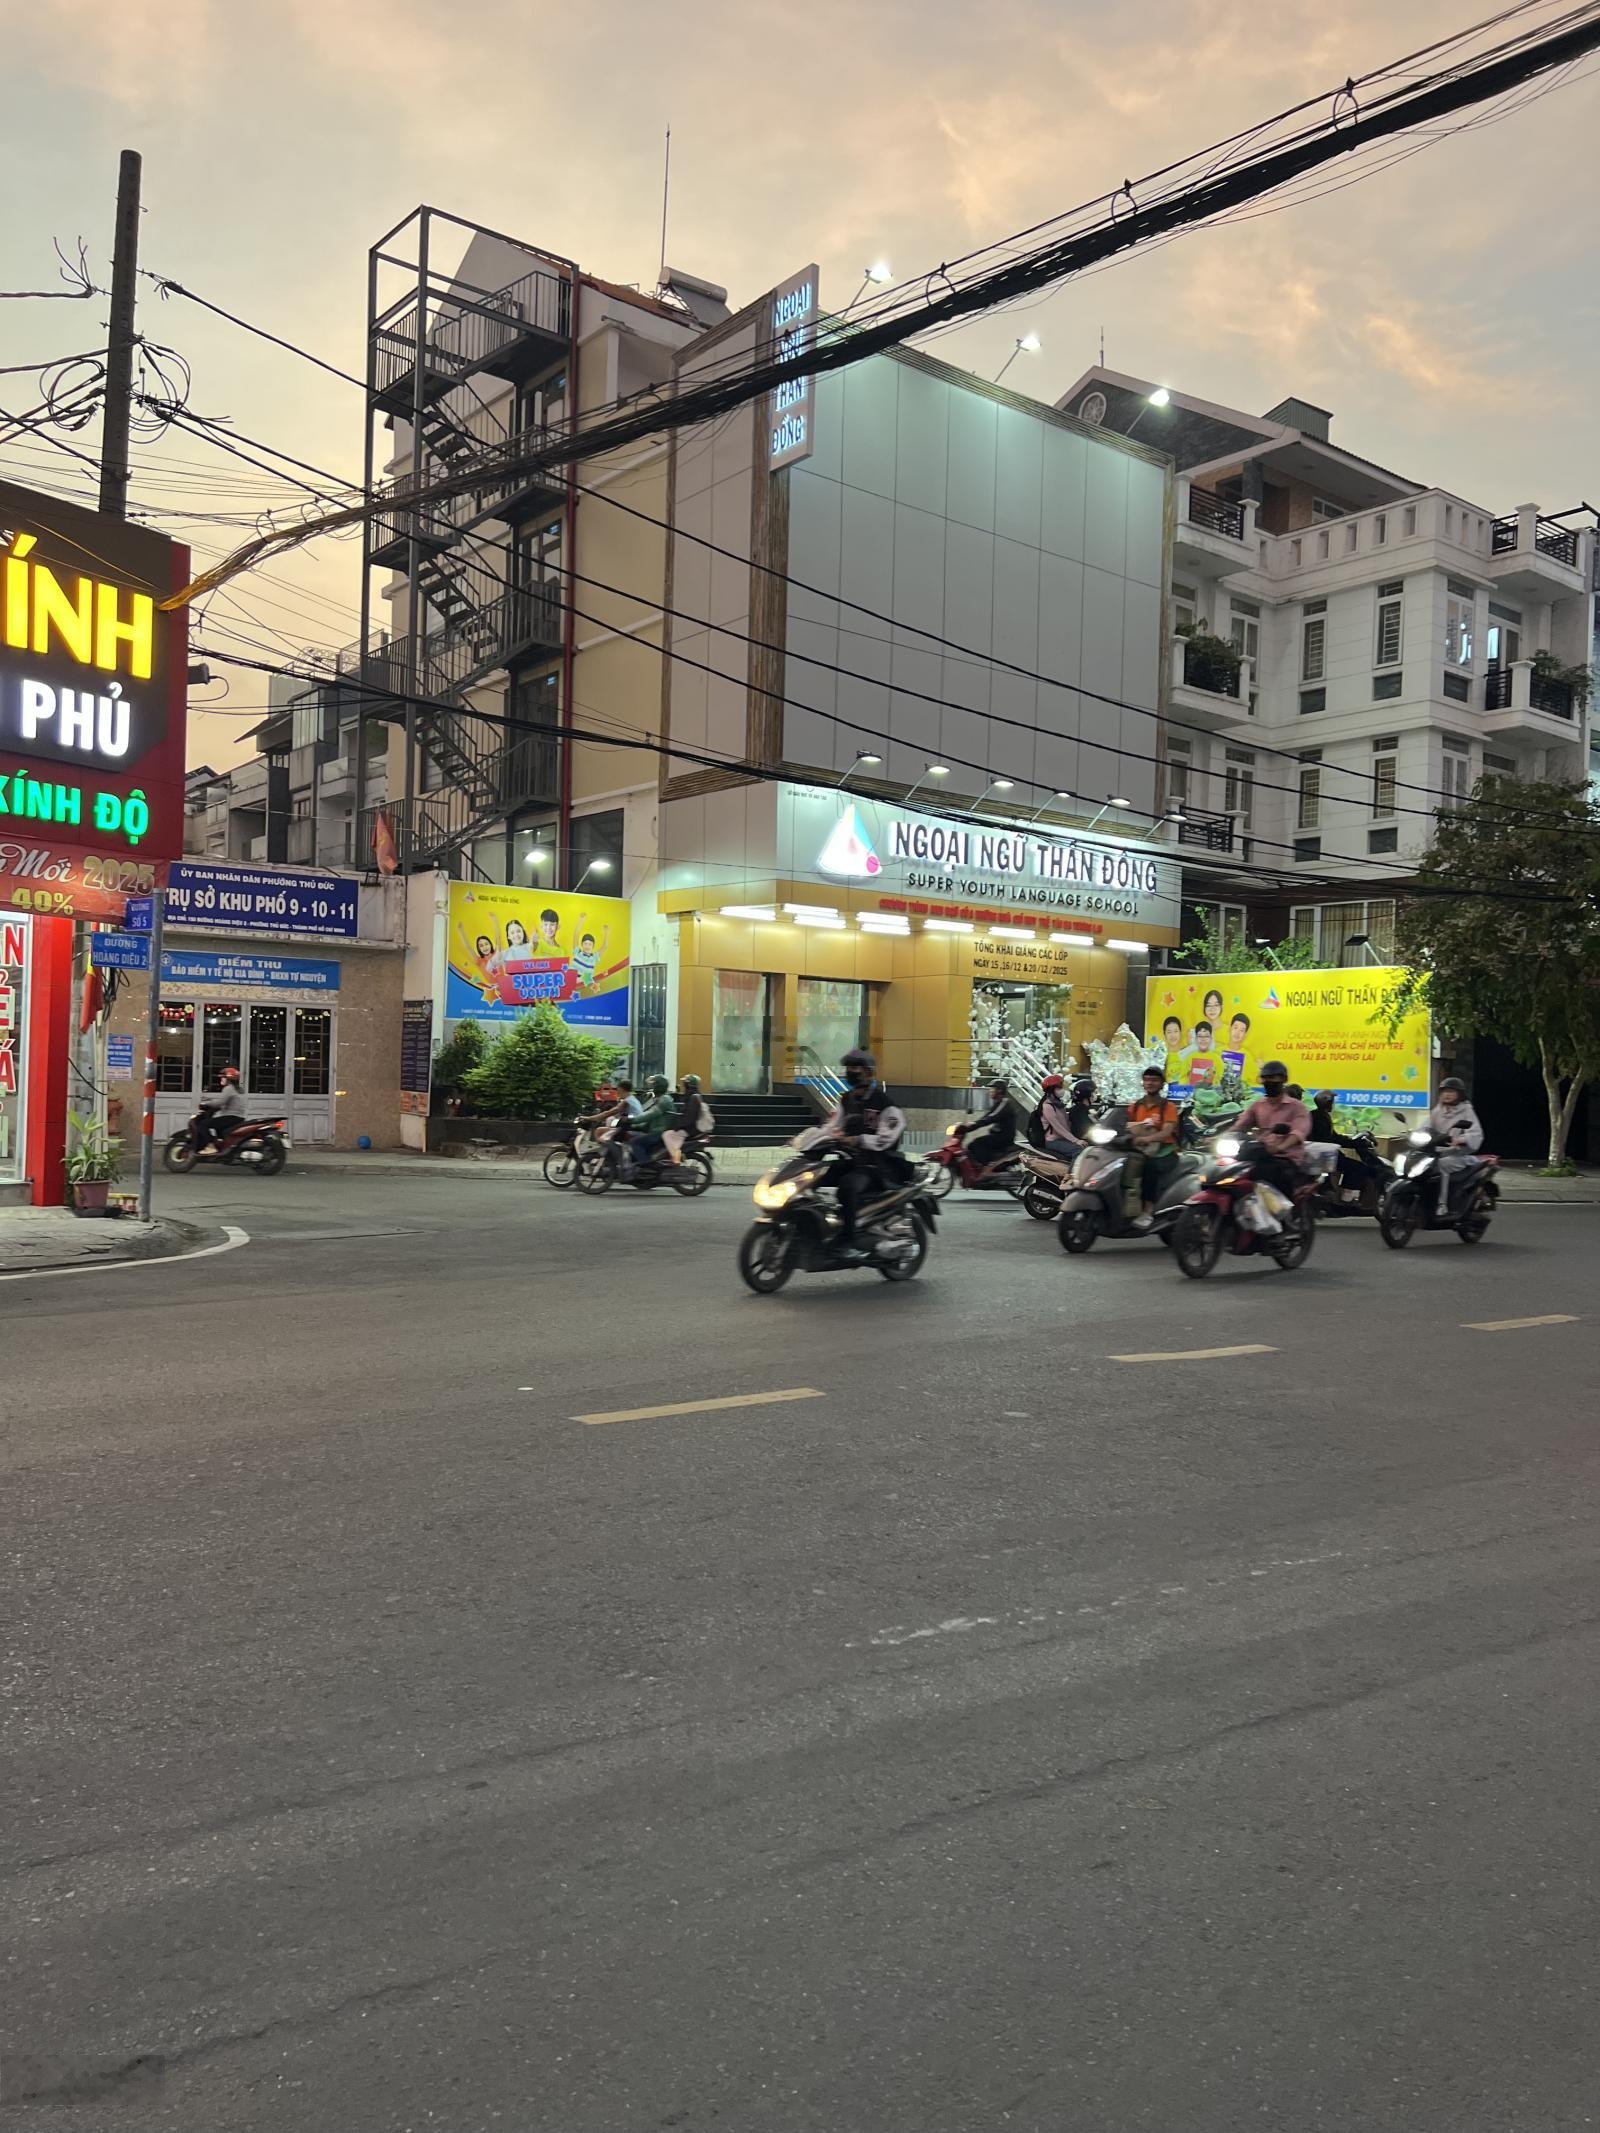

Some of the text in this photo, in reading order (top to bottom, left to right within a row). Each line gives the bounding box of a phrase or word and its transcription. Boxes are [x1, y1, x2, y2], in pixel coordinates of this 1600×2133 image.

[22, 679, 131, 756] PHỦ
[94, 789, 149, 845] ĐỘ
[893, 822, 969, 870] NGOẠI
[980, 834, 1029, 872] NGỮ
[82, 856, 155, 896] 2025
[195, 871, 214, 880] BAN
[215, 873, 241, 882] NHÂN
[242, 875, 260, 884] DÂN
[262, 877, 297, 887] PHƯỜNG
[299, 880, 316, 889] THỦ
[317, 881, 335, 891] ĐỨC
[11, 887, 74, 916] 40%
[194, 884, 216, 909] SỞ
[220, 892, 252, 912] KHU
[255, 890, 287, 915] PHỐ
[290, 898, 299, 916] 9
[311, 900, 328, 918] 10
[340, 903, 354, 920] 11
[908, 872, 1139, 915] SUPER YOUTH LANGUAGE SCHOOL
[142, 916, 147, 927] 5
[93, 950, 120, 964] HOÀNG
[141, 955, 147, 966] 2
[996, 944, 1014, 956] KHAI
[1038, 946, 1053, 960] CÁC
[218, 956, 282, 969] ĐIỂM THU
[973, 956, 990, 968] NGÀY
[207, 967, 213, 977] Y
[512, 972, 566, 990] SUPER
[519, 987, 561, 1000] YOUTH
[1286, 990, 1318, 1009] NGOẠI
[1320, 986, 1344, 1006] NGỮ
[1347, 983, 1377, 1005] THẦN
[1276, 1041, 1293, 1050] CỦA
[1296, 1041, 1327, 1050] NHỮNG
[1329, 1041, 1347, 1050] NHÀ
[1368, 1042, 1387, 1050] HUY
[1316, 1053, 1327, 1061] BA
[1330, 1052, 1360, 1061] TƯƠNG
[1362, 1053, 1376, 1061] LAI
[1345, 1092, 1370, 1103] 1900
[1371, 1093, 1391, 1104] 599
[1393, 1094, 1414, 1105] 839
